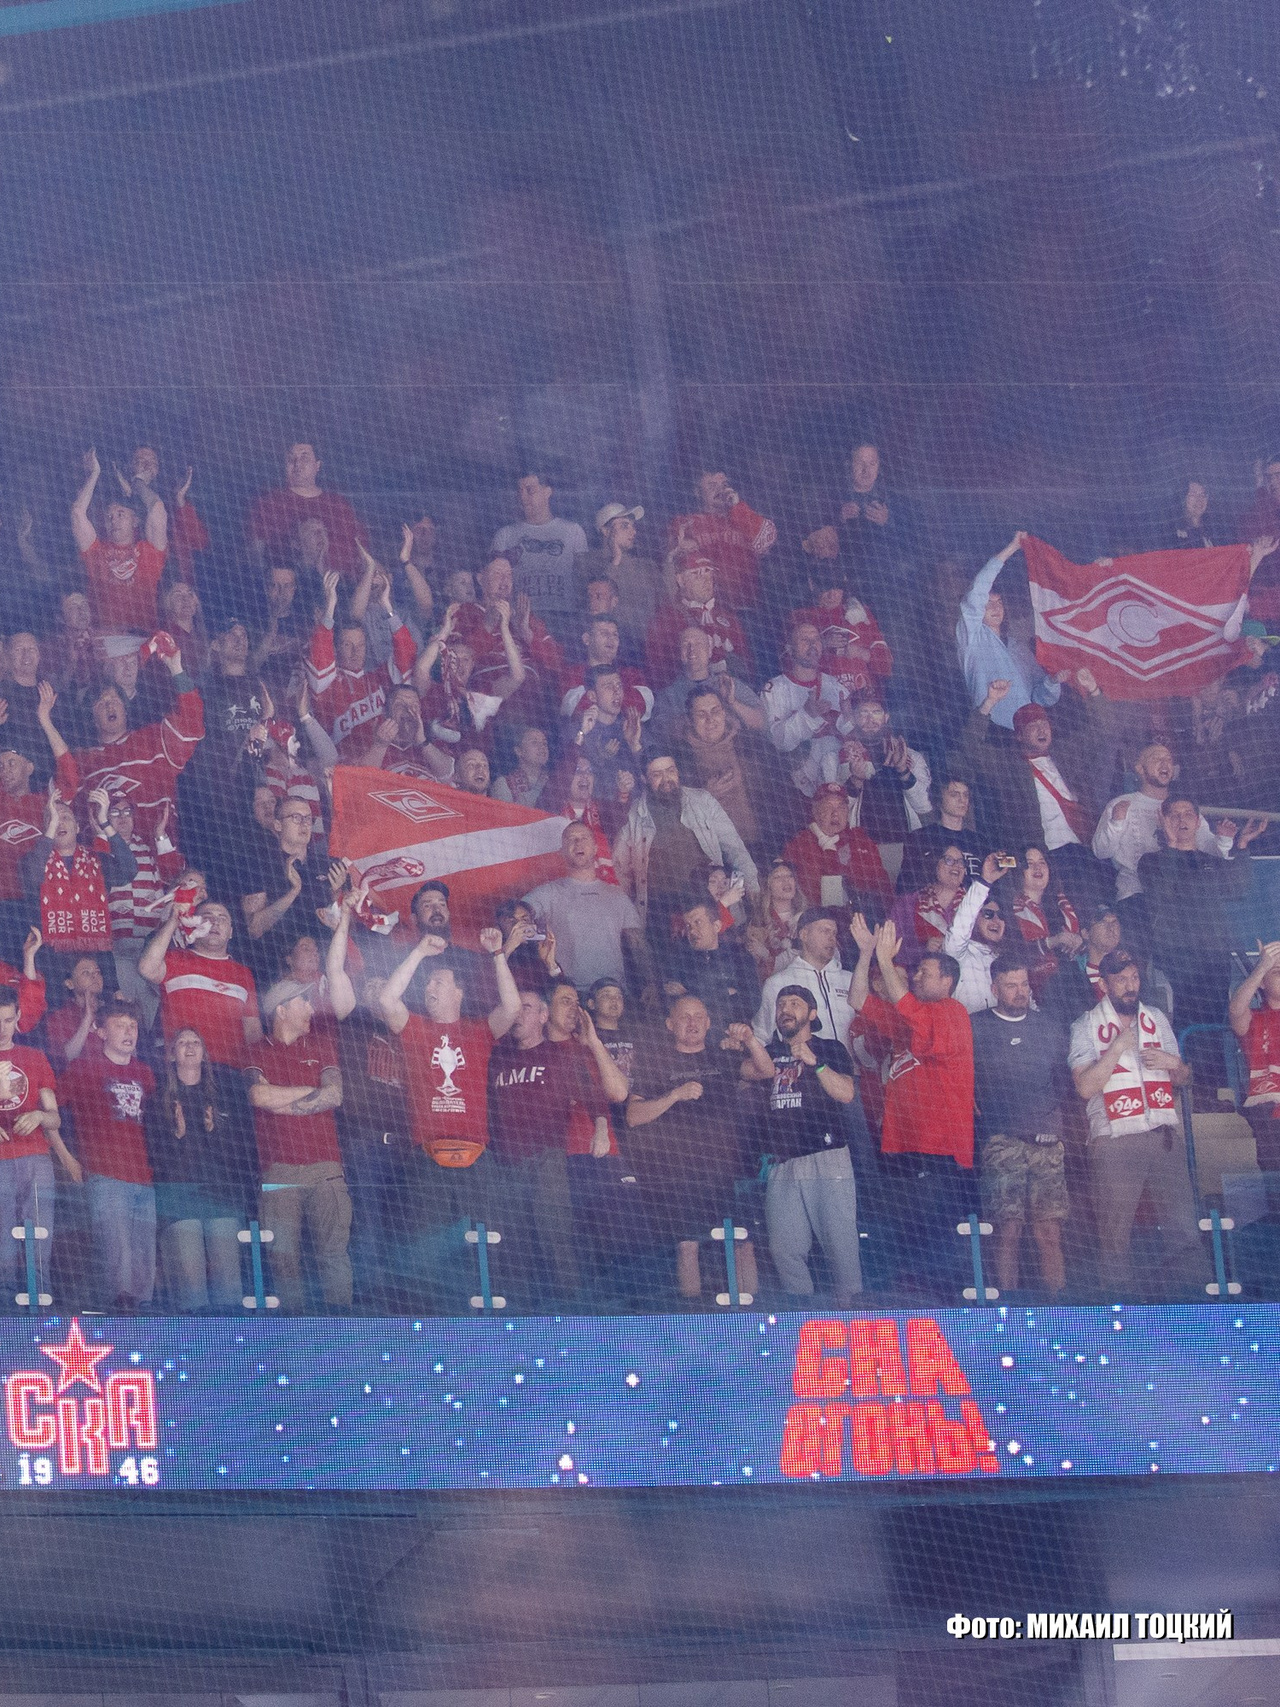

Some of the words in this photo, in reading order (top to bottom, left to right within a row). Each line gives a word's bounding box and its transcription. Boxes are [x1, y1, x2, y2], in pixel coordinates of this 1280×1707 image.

[47, 911, 57, 934] ONE
[57, 910, 67, 934] FOR
[66, 911, 75, 934] ALL
[81, 909, 90, 933] ONE
[90, 909, 99, 933] FOR
[98, 909, 107, 933] ALL
[1108, 1096, 1144, 1114] 1946
[5, 1370, 158, 1476] СКА
[19, 1454, 54, 1485] 19
[119, 1457, 159, 1485] 46
